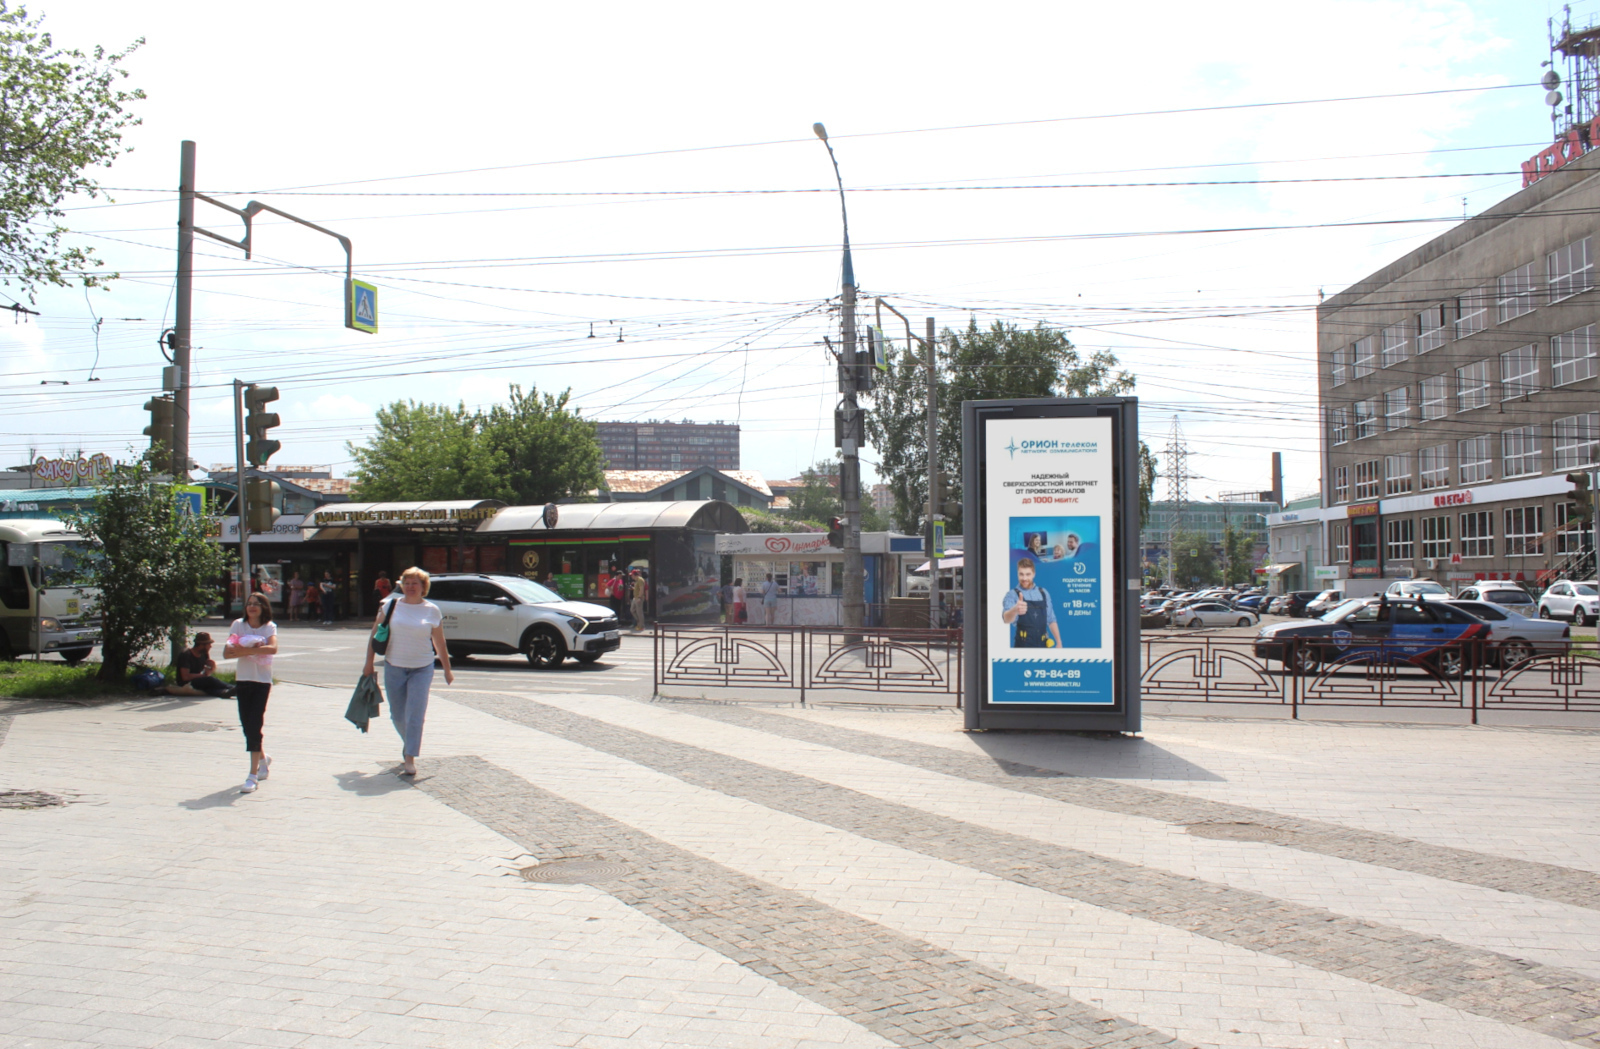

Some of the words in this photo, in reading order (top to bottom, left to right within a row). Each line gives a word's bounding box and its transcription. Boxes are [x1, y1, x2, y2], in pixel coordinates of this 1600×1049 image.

[1521, 129, 1583, 188] МЕХА
[1021, 440, 1058, 448] ОРИОН
[1033, 496, 1053, 504] 1000
[315, 508, 447, 524] ДИАГНОСТИЧЕСКИЙ
[450, 507, 497, 520] ЦЕНТР
[1072, 600, 1082, 608] 18
[1033, 669, 1081, 678] 79-84-89
